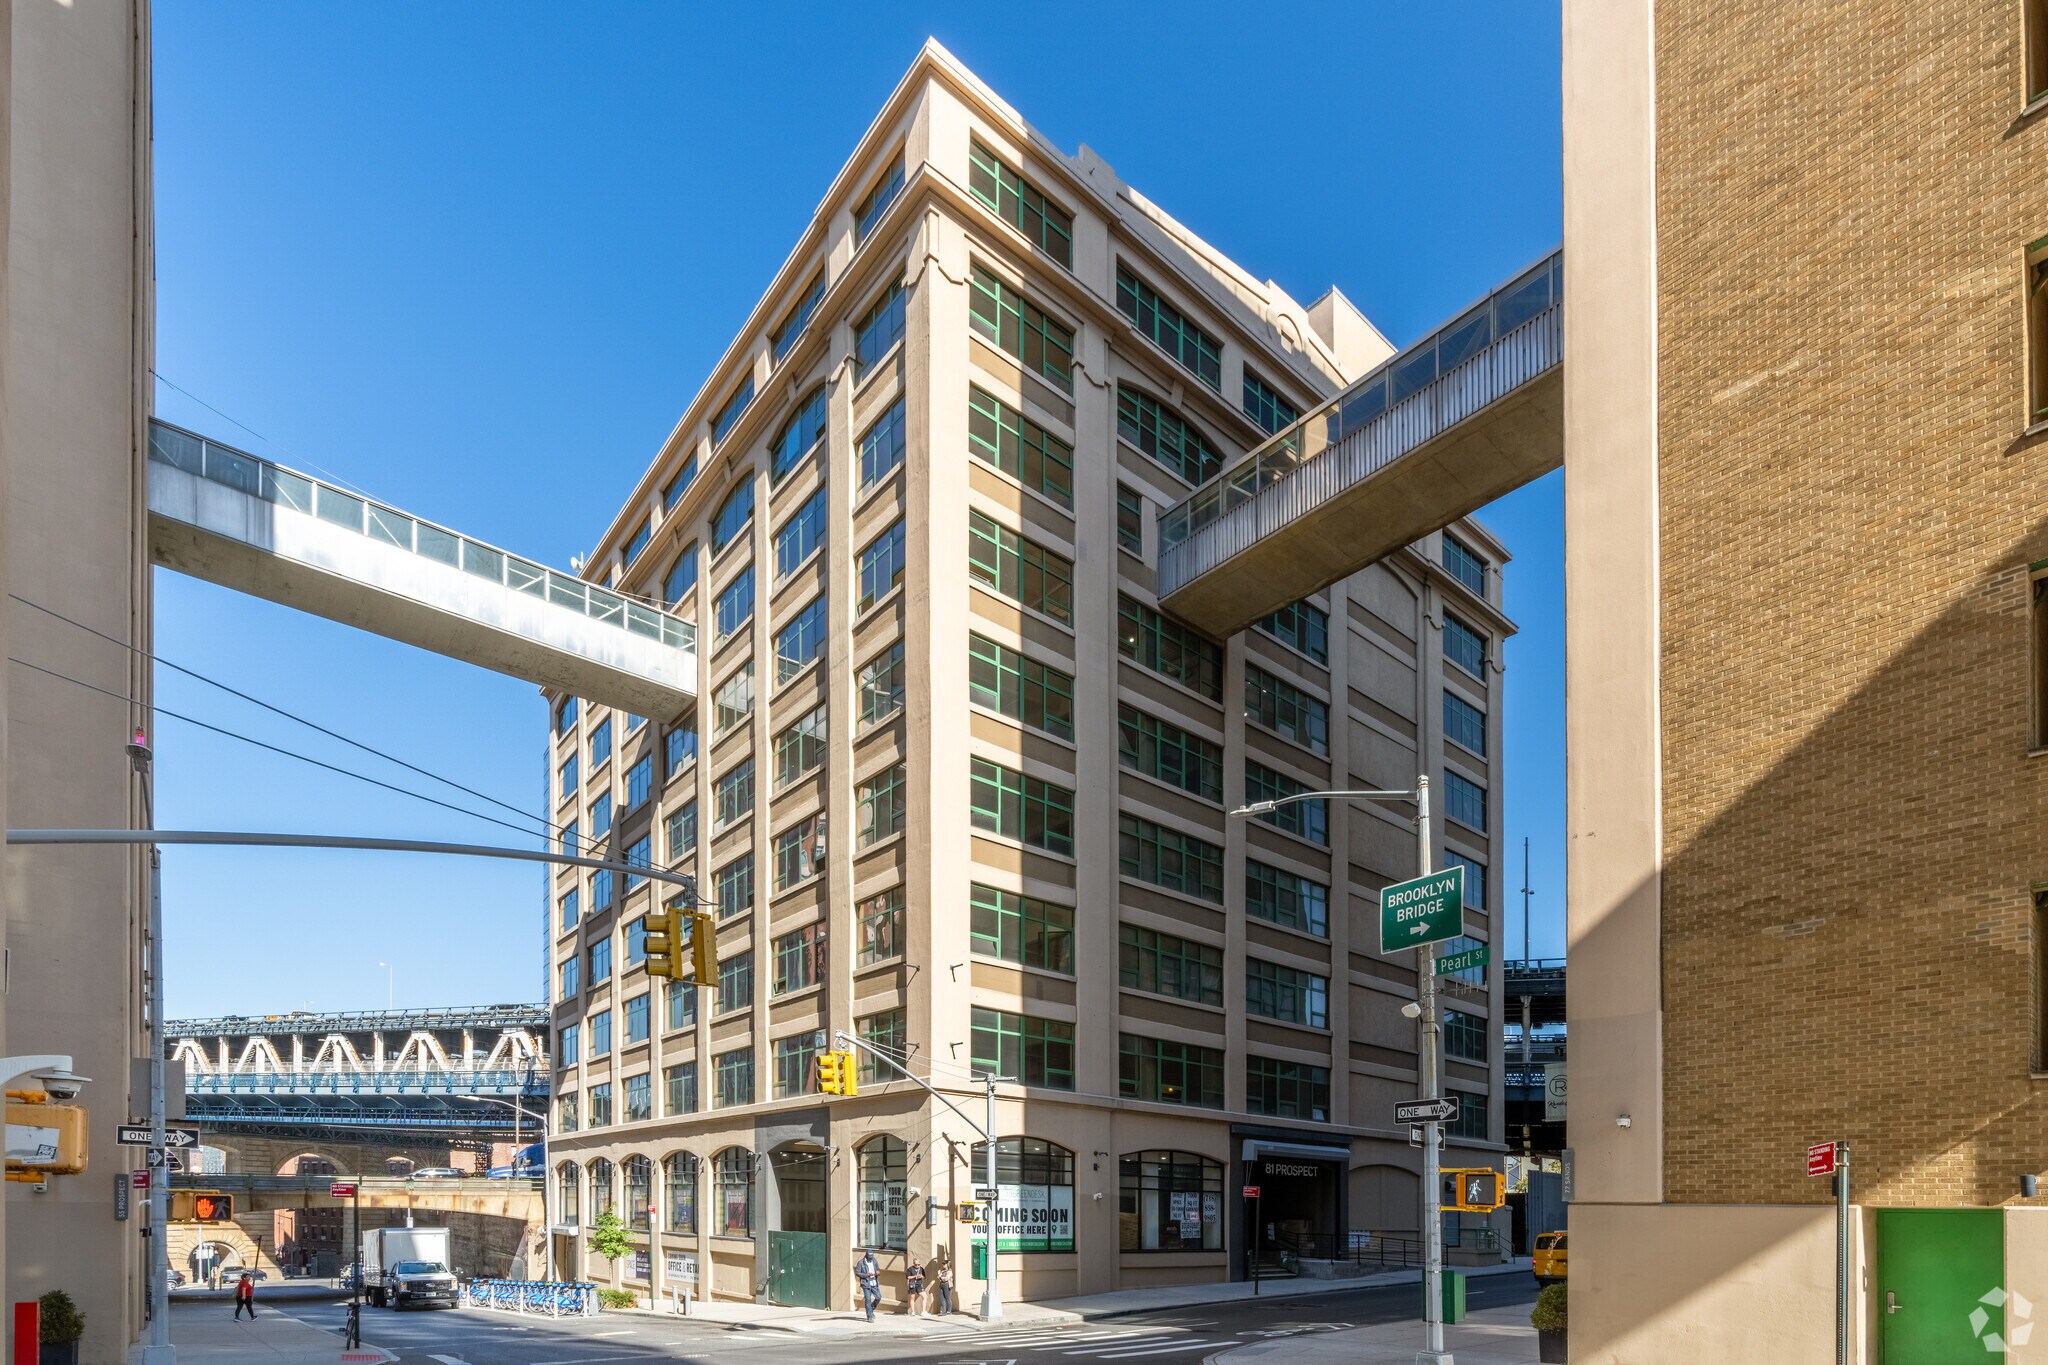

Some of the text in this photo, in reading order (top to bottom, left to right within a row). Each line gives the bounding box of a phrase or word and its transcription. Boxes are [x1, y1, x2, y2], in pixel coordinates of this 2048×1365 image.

[1388, 878, 1455, 908] BROOKLYN
[1397, 898, 1444, 922] BRIDGE
[1441, 950, 1483, 972] Pearl St
[1400, 1105, 1450, 1117] ONE WAY
[129, 1132, 186, 1142] ONE WAY
[1414, 1130, 1424, 1139] ONE
[1265, 1163, 1318, 1177] 81 PROSPECT
[888, 1187, 901, 1196] YOUR
[888, 1197, 905, 1206] OFFICE
[889, 1207, 902, 1216] HERE
[974, 1206, 1068, 1223] COMING SOON
[972, 1225, 1047, 1235] YOU OFFICE HERE
[668, 1261, 681, 1272] OFFICE
[687, 1263, 699, 1273] RETAI
